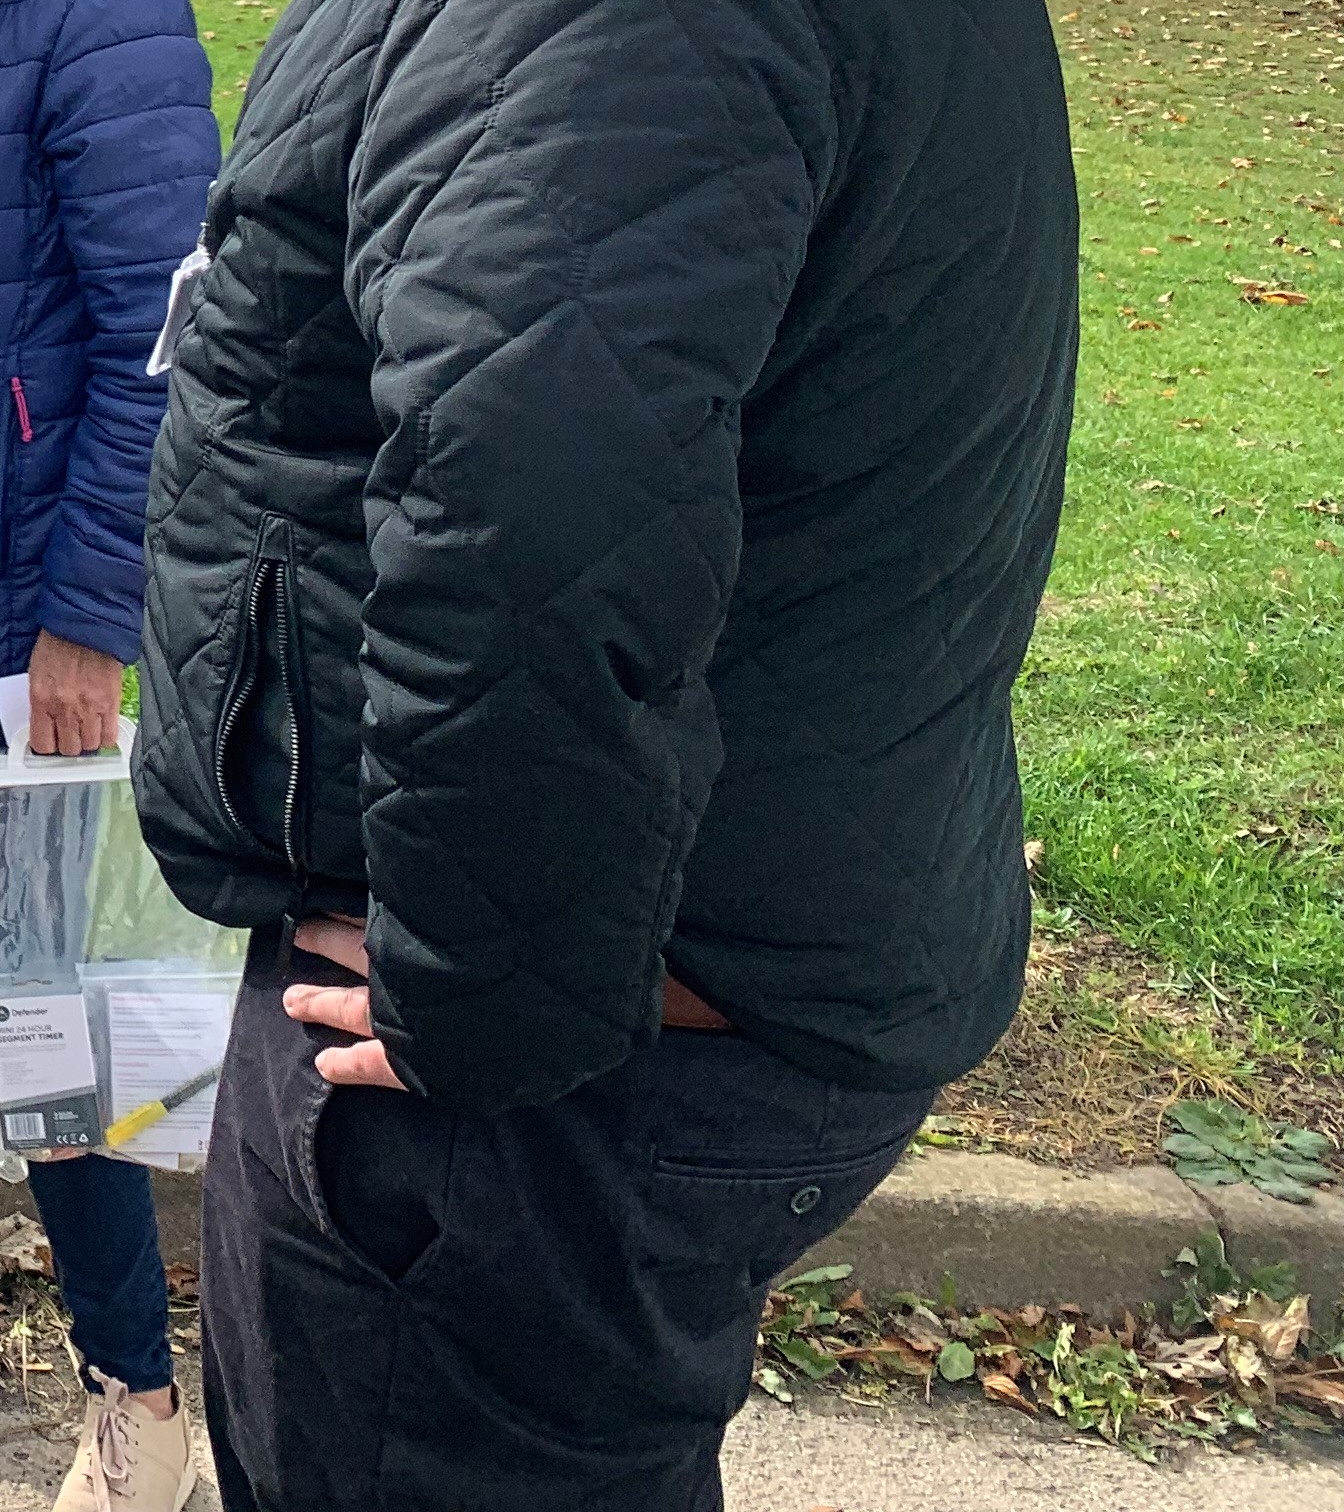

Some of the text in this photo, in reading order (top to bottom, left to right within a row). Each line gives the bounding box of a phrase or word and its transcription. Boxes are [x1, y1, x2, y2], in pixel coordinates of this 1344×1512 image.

[12, 1008, 48, 1017] Defender
[28, 1024, 52, 1032] HOUR
[38, 1032, 64, 1041] TIMER
